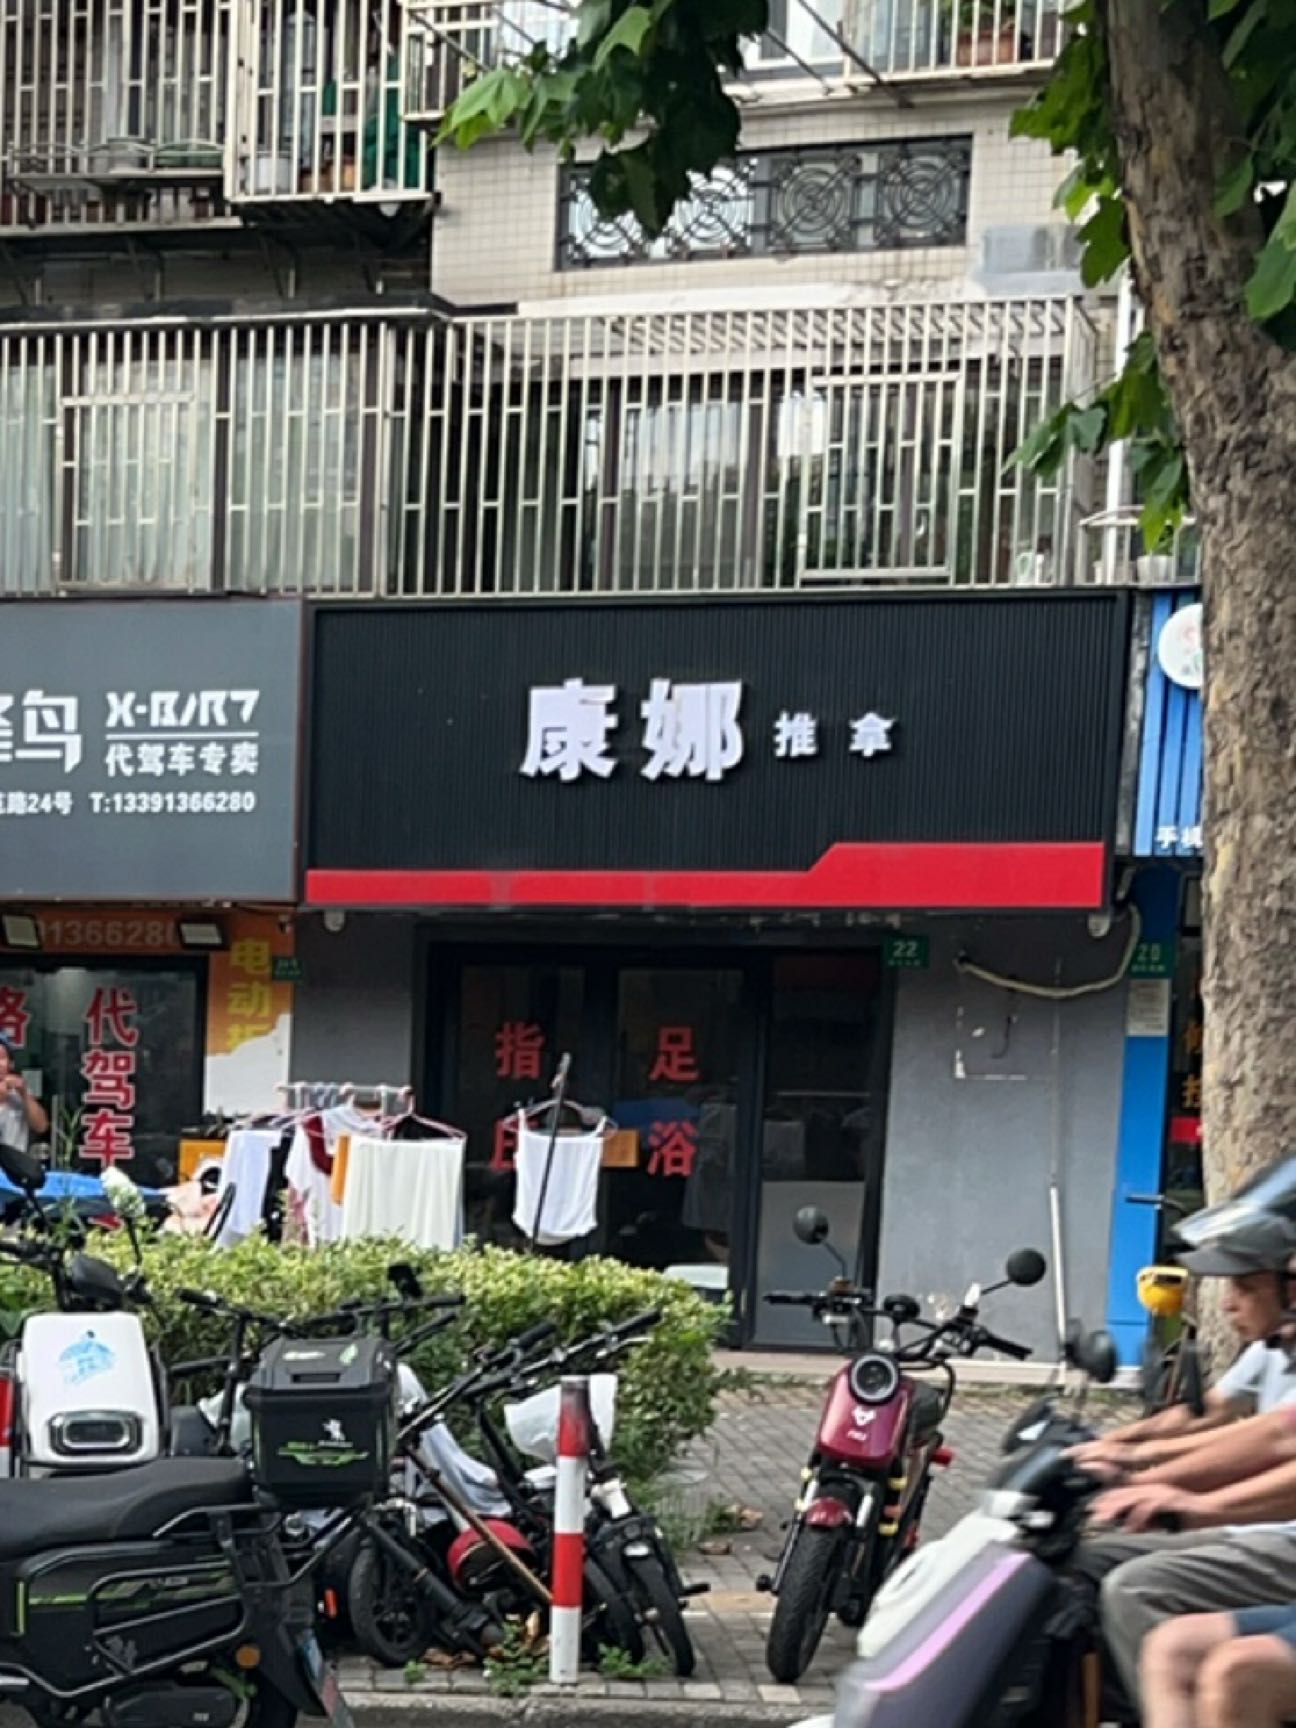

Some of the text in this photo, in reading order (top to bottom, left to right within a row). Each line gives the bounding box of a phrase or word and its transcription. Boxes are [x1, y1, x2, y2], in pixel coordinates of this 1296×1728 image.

[519, 678, 895, 781] 康娜 推拿
[106, 742, 259, 777] 代驾车专卖
[89, 791, 256, 814] T:13391366280
